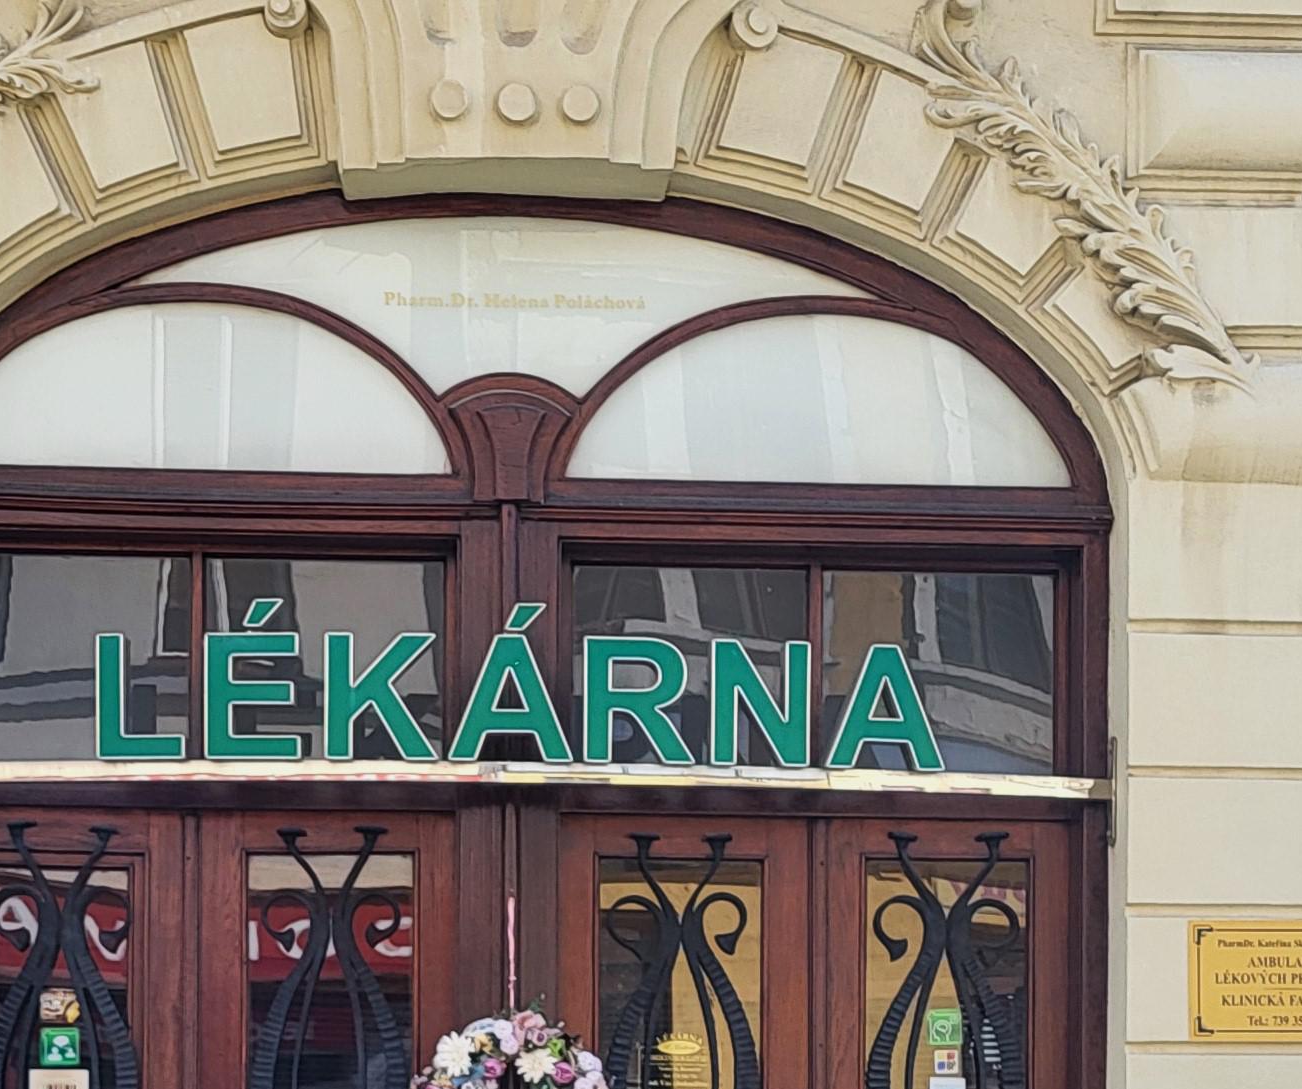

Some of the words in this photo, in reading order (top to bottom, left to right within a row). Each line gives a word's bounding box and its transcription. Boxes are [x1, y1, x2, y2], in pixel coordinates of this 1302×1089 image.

[483, 292, 550, 309] Helena
[554, 293, 647, 310] Poláchová
[94, 598, 946, 773] LÉKÁRNA
[1214, 969, 1287, 985] LÉKOVÝCH
[1221, 991, 1286, 1007] KLINICKÁ
[1272, 1015, 1290, 1027] 739
